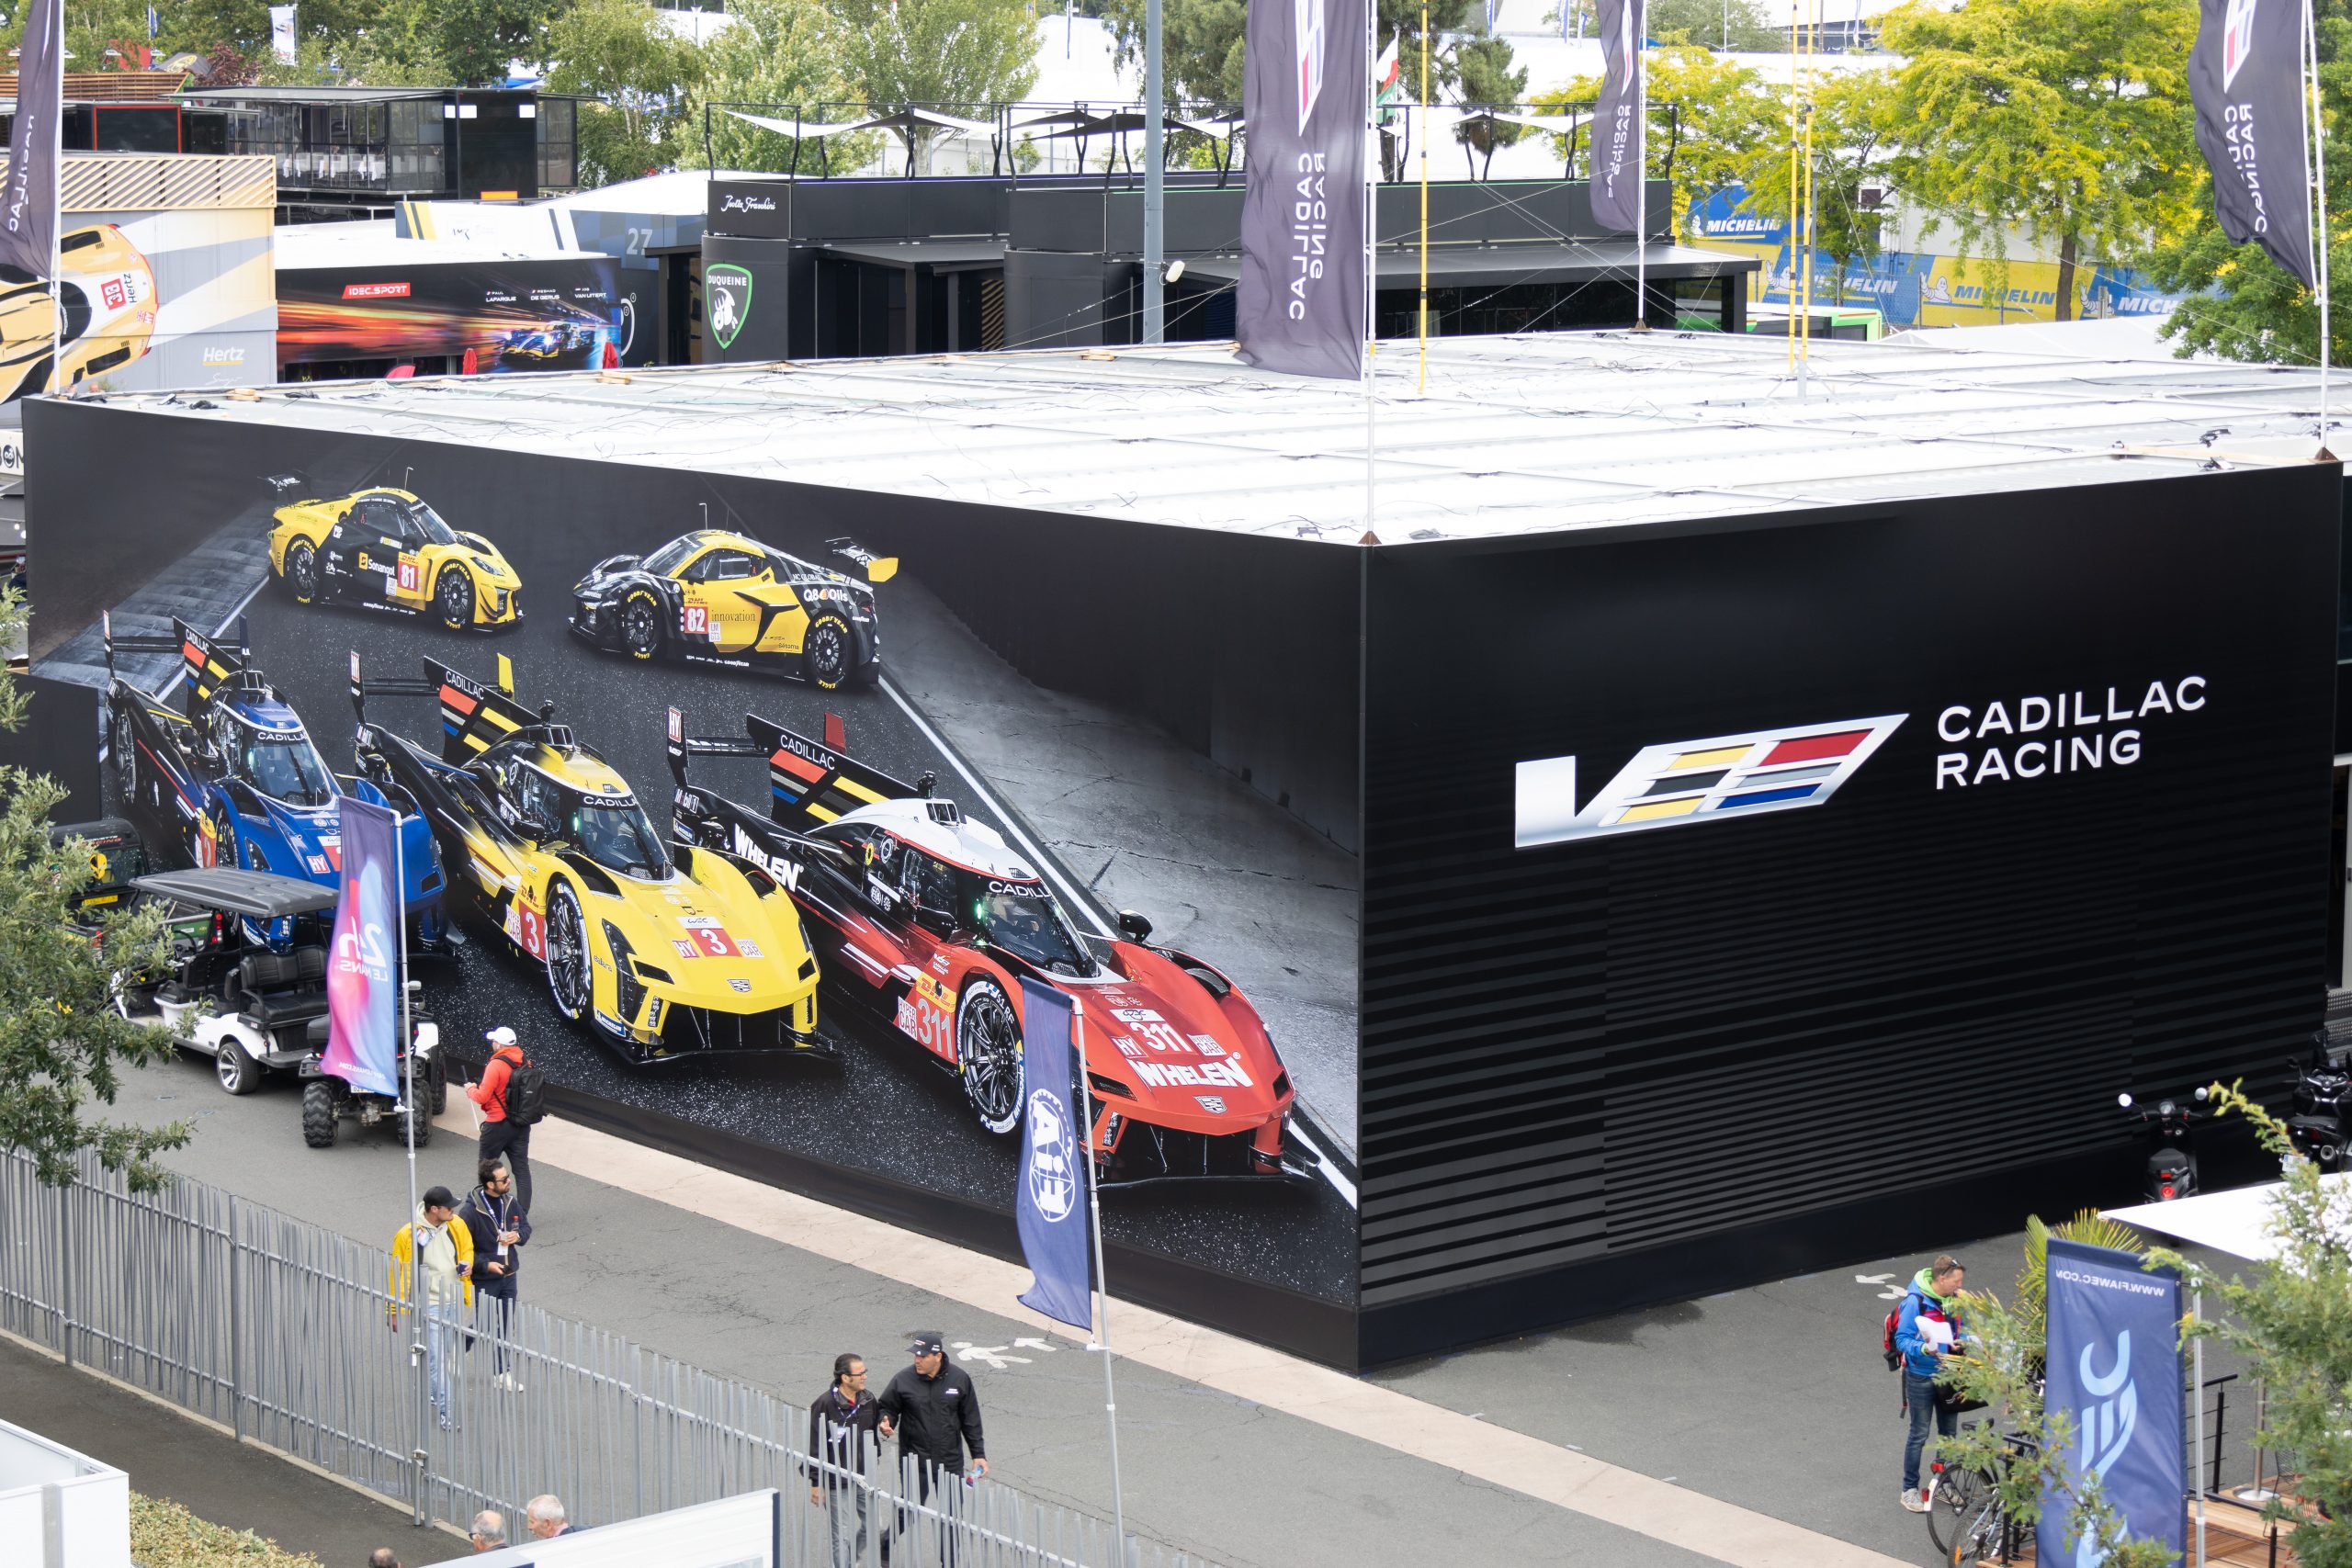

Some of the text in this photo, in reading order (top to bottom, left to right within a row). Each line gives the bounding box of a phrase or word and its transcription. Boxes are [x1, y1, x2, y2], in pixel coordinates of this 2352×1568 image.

[626, 227, 653, 255] 27
[123, 272, 138, 304] Hertz
[707, 276, 747, 287] DUQUEINE
[2119, 296, 2180, 314] MICH
[203, 346, 245, 362] Hertz
[368, 558, 396, 577] Sonangol
[401, 564, 415, 589] 81
[687, 607, 706, 632] 82
[711, 609, 756, 622] innovation
[815, 615, 848, 635] GOODYEAR
[186, 628, 209, 655] CADILLAC
[446, 671, 485, 700] CADILLAC
[1938, 676, 2206, 742] CADILLAC
[257, 731, 307, 741] CADILLA
[669, 709, 681, 741] HY
[781, 735, 835, 771] CADILLAC
[1936, 730, 2141, 790] RACING
[583, 795, 639, 807] CADILLA
[309, 855, 327, 873] HY
[734, 823, 800, 892] WHELEN
[989, 881, 1052, 897] CADILL
[526, 911, 540, 954] 3
[701, 929, 728, 954] 3
[673, 941, 696, 956] HY
[899, 998, 917, 1019] HYPER
[899, 1010, 917, 1039] CAR
[918, 998, 953, 1059] 311
[1130, 1022, 1193, 1051] 311
[1113, 1037, 1142, 1055] HY
[1197, 1043, 1224, 1055] CAR
[1126, 1056, 1254, 1087] WHELEN
[1014, 1066, 1024, 1119] MICHELIN
